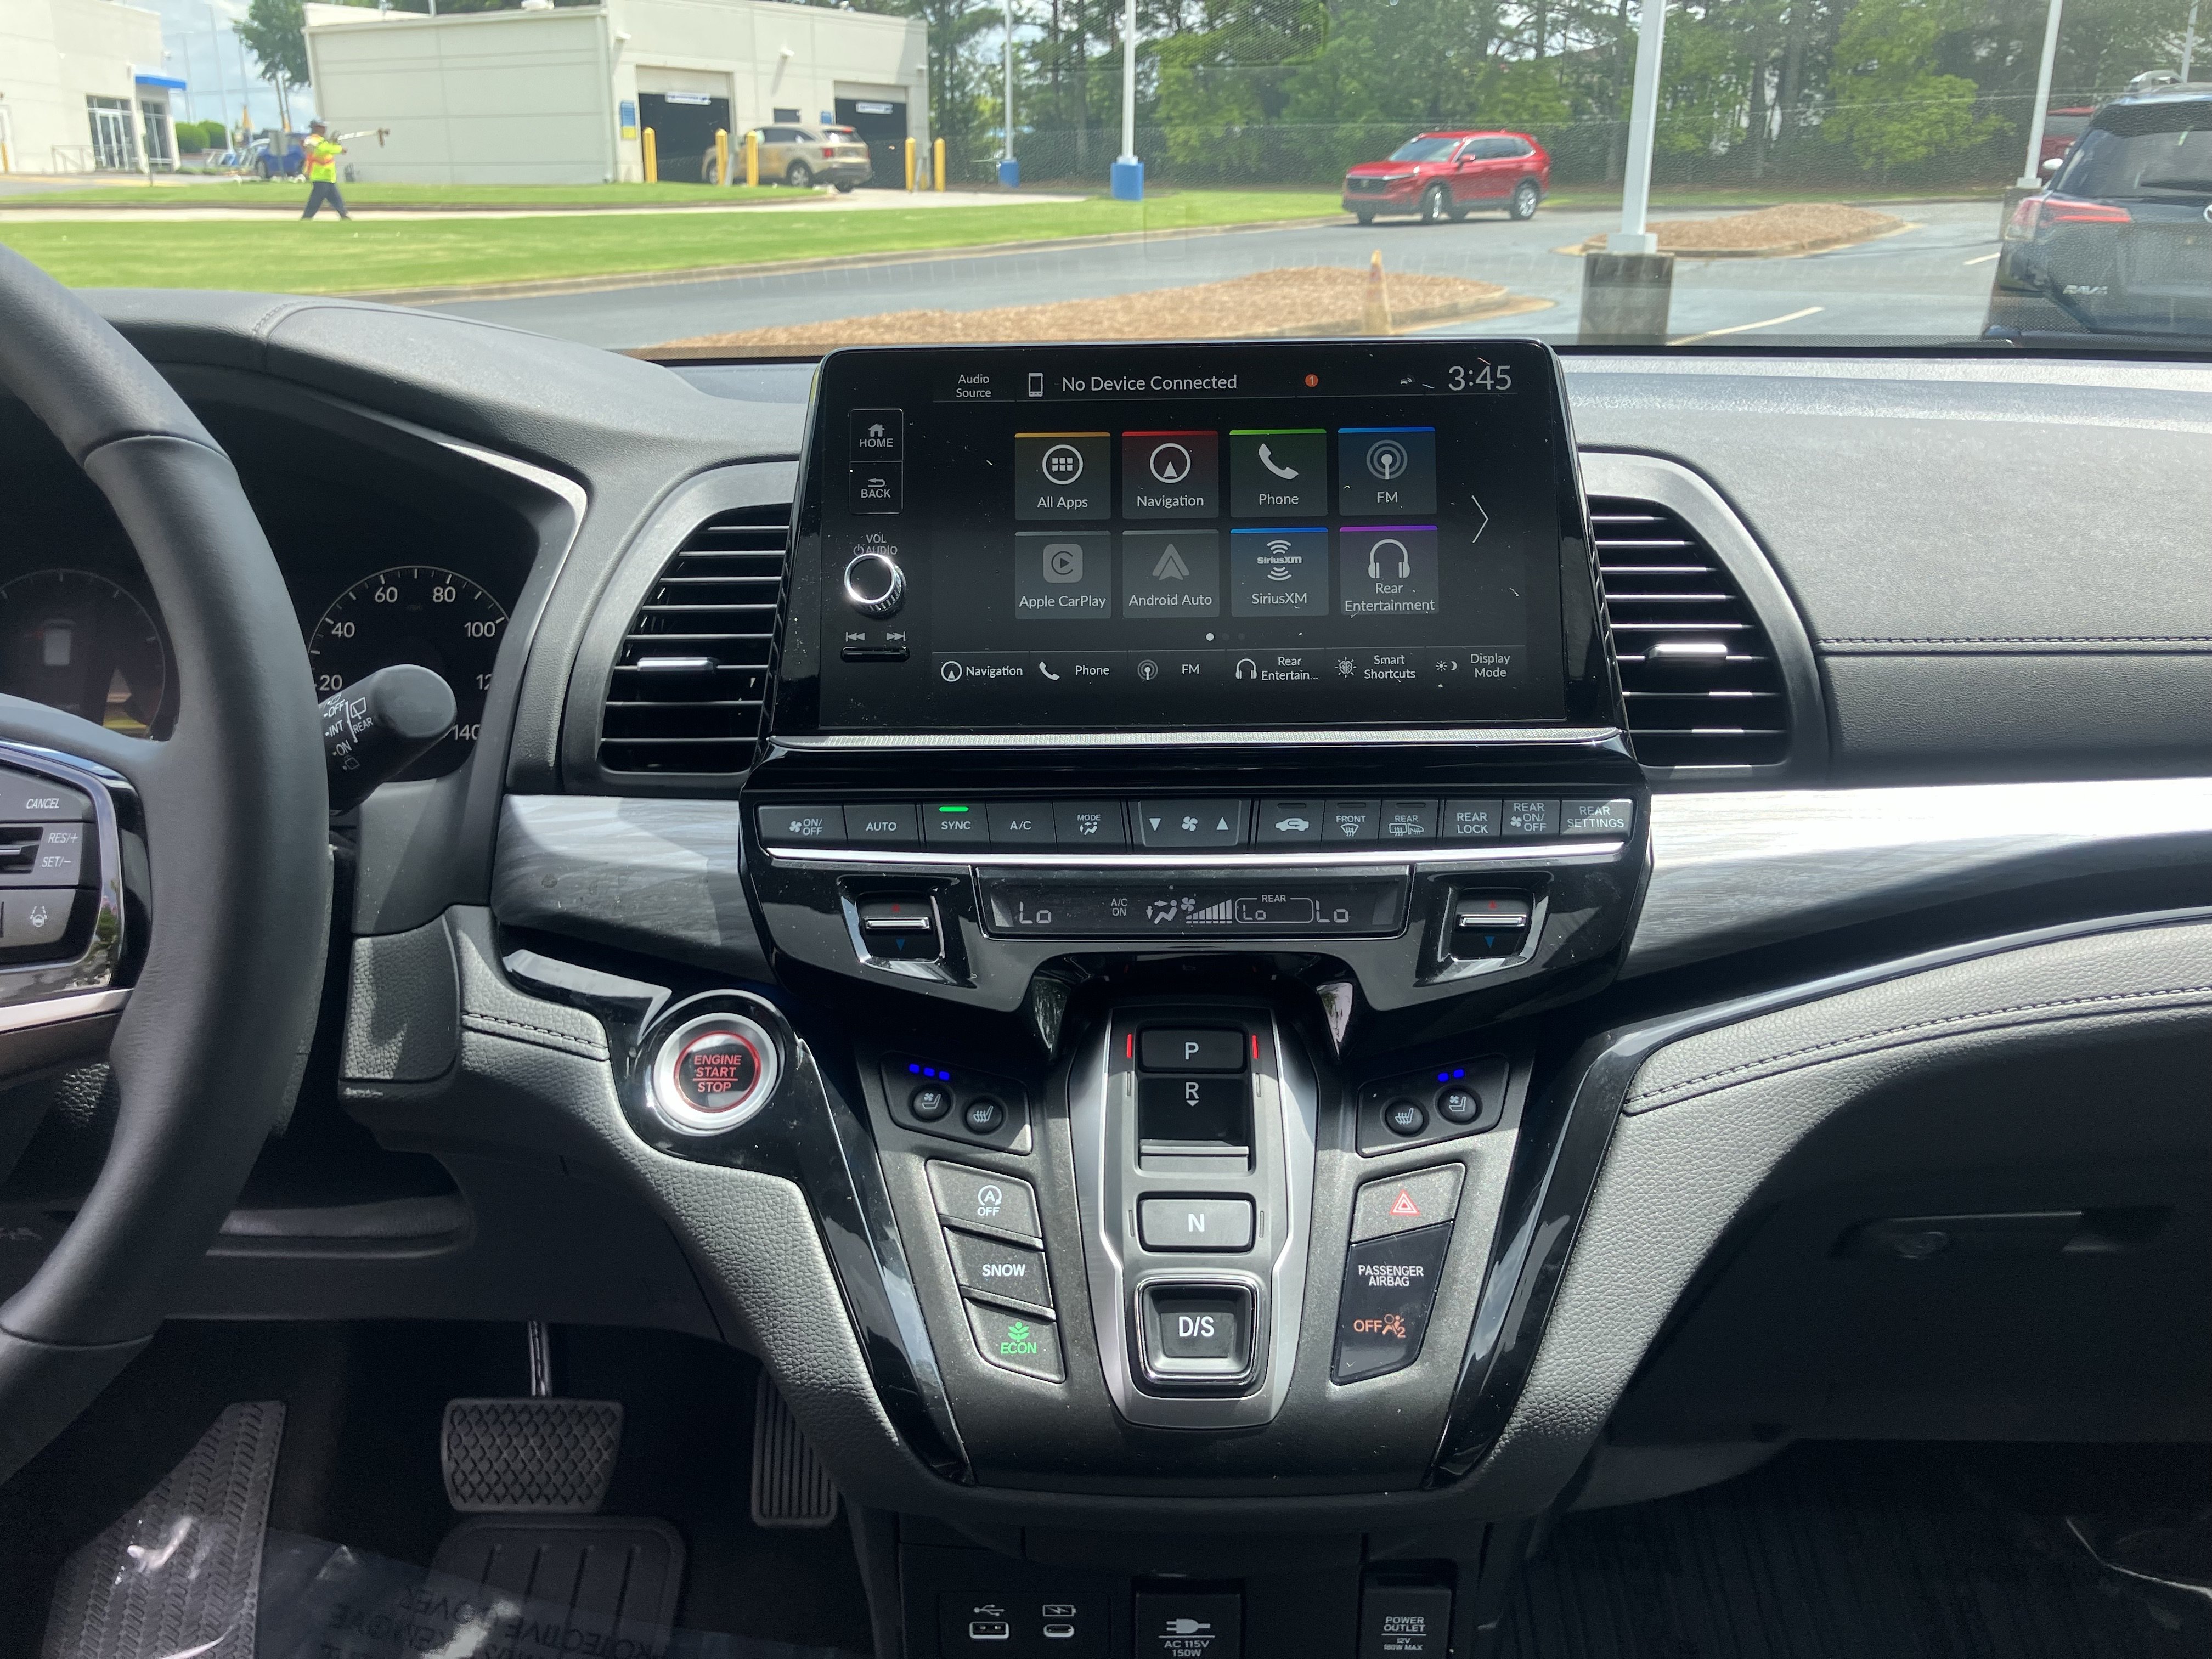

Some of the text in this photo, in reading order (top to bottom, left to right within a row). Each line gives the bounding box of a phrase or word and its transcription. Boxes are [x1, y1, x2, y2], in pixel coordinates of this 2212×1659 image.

[958, 374, 989, 383] Audio
[1063, 375, 1236, 391] No Device Connected
[1449, 365, 1511, 391] 3:45
[956, 388, 991, 397] Source
[860, 438, 893, 447] HOME
[861, 489, 890, 498] BACK
[1378, 492, 1397, 503] FM
[1037, 496, 1087, 510] All Apps
[1138, 495, 1203, 508] Navigation
[1260, 494, 1299, 505] Phone
[866, 534, 887, 543] VOL
[866, 546, 897, 556] AUDIO
[1376, 583, 1403, 593] Rear
[375, 587, 397, 602] 60
[433, 587, 455, 602] 80
[1129, 594, 1211, 606] Android Auto
[1252, 592, 1306, 604] SiriusXM
[1019, 595, 1106, 609] Apple CarPlay
[1345, 600, 1435, 613] Entertainment
[332, 622, 355, 637] 40
[465, 622, 495, 637] 100
[1278, 657, 1301, 666] Rear
[1374, 655, 1404, 664] Smart
[1471, 653, 1510, 665] Display
[967, 666, 1023, 678] Navigation
[1076, 665, 1109, 675] Phone
[1182, 664, 1199, 674] FM
[1364, 669, 1415, 679] Shortcuts
[1475, 667, 1506, 677] Mode
[1262, 670, 1318, 680] Entertain...
[320, 675, 342, 690] 20
[476, 674, 492, 690] 12
[329, 699, 345, 716] OFF
[329, 719, 343, 737] INT
[352, 716, 374, 734] REAR
[336, 740, 352, 756] ON
[26, 798, 59, 809] CANCEL
[1514, 803, 1545, 811] REAR
[1457, 812, 1487, 821] REAR
[1580, 806, 1611, 816] REAR
[1523, 814, 1544, 822] ON/
[1567, 819, 1624, 827] SETTINGS
[866, 822, 896, 831] AUTO
[941, 821, 970, 830] SYNC
[1010, 821, 1031, 830] A/C
[1457, 825, 1488, 833] LOCK
[1524, 823, 1546, 831] OFF
[48, 833, 78, 843] RES/+
[1111, 898, 1127, 906] A/C
[1019, 902, 1051, 924] Lo
[1113, 907, 1126, 916] ON
[1243, 905, 1266, 920] Lo
[1316, 900, 1348, 923] Lo
[1186, 1042, 1199, 1059] P
[694, 1055, 741, 1065] ENGINE
[696, 1067, 736, 1077] START
[698, 1082, 731, 1092] STOP
[1186, 1082, 1199, 1099] R
[977, 1207, 1000, 1216] OFF
[1188, 1214, 1204, 1232] N
[982, 1264, 1025, 1277] SNOW
[1358, 1265, 1424, 1278] PASSENGER
[1369, 1276, 1409, 1286] AIRBAG
[1179, 1316, 1214, 1337] D/S
[1354, 1320, 1382, 1332] OFF
[1001, 1342, 1037, 1354] ECON
